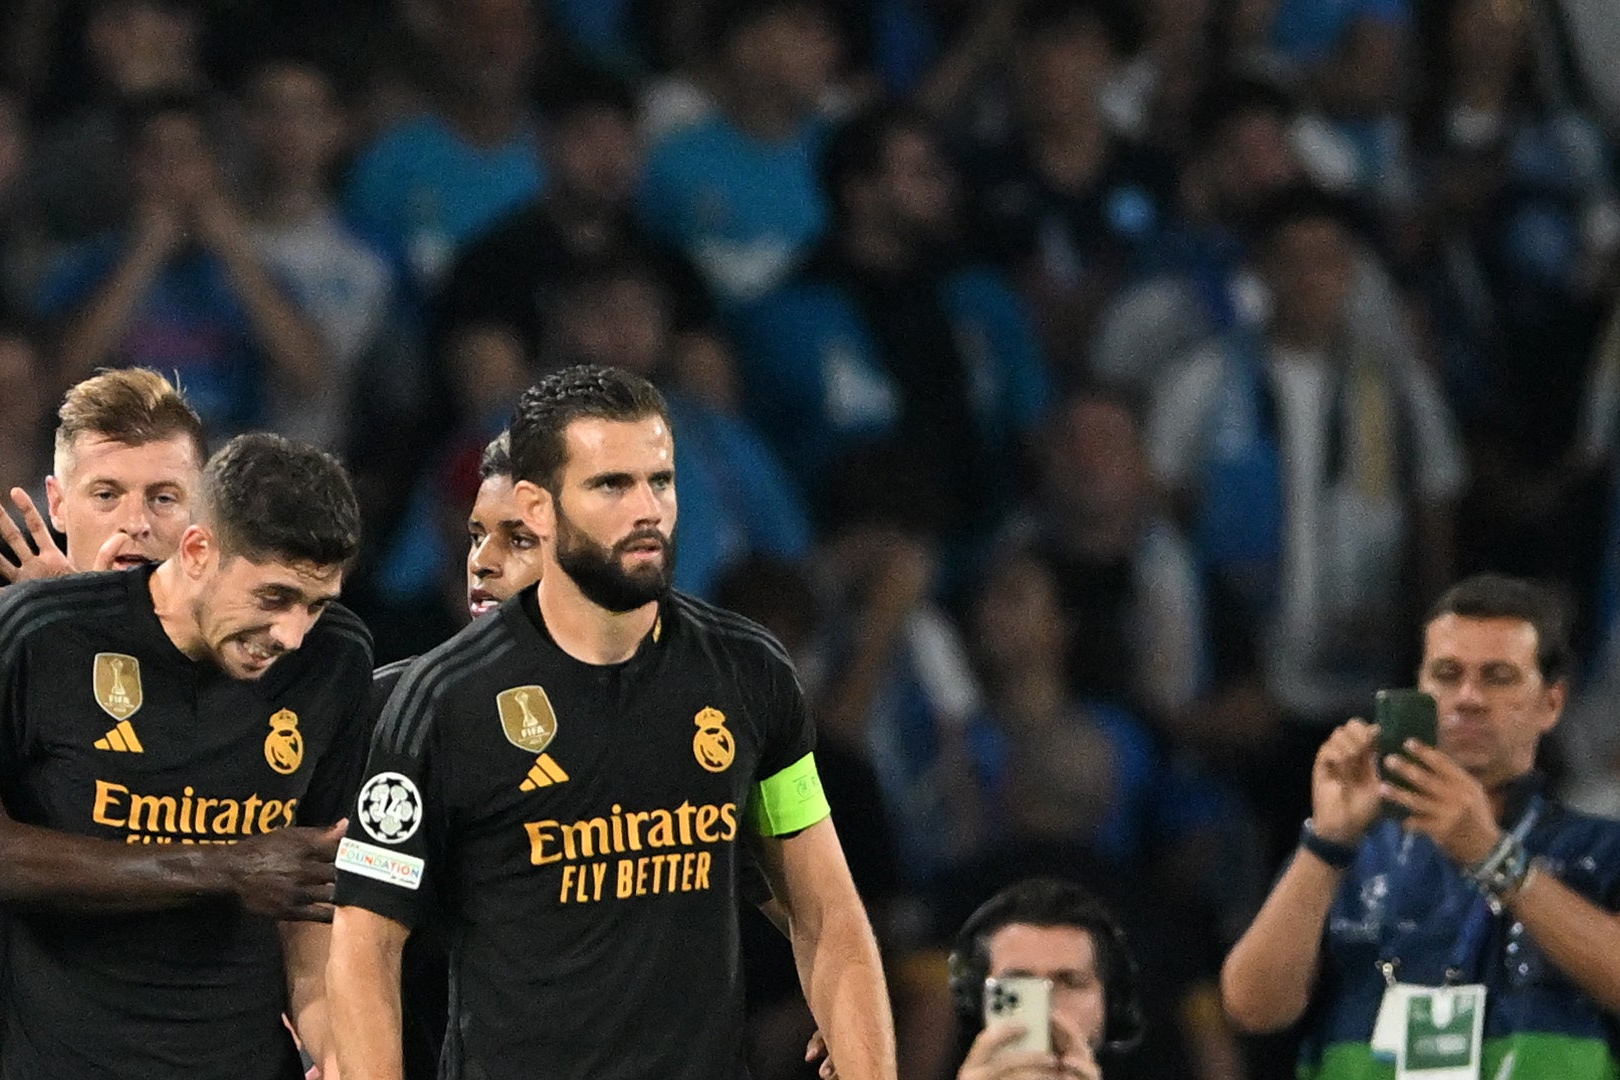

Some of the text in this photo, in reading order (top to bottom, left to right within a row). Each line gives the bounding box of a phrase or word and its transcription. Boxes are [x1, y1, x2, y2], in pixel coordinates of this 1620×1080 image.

[521, 725, 544, 738] FIFA
[92, 780, 298, 835] Emirates
[524, 800, 738, 866] Emirates
[560, 851, 712, 903] FLY BETTER
